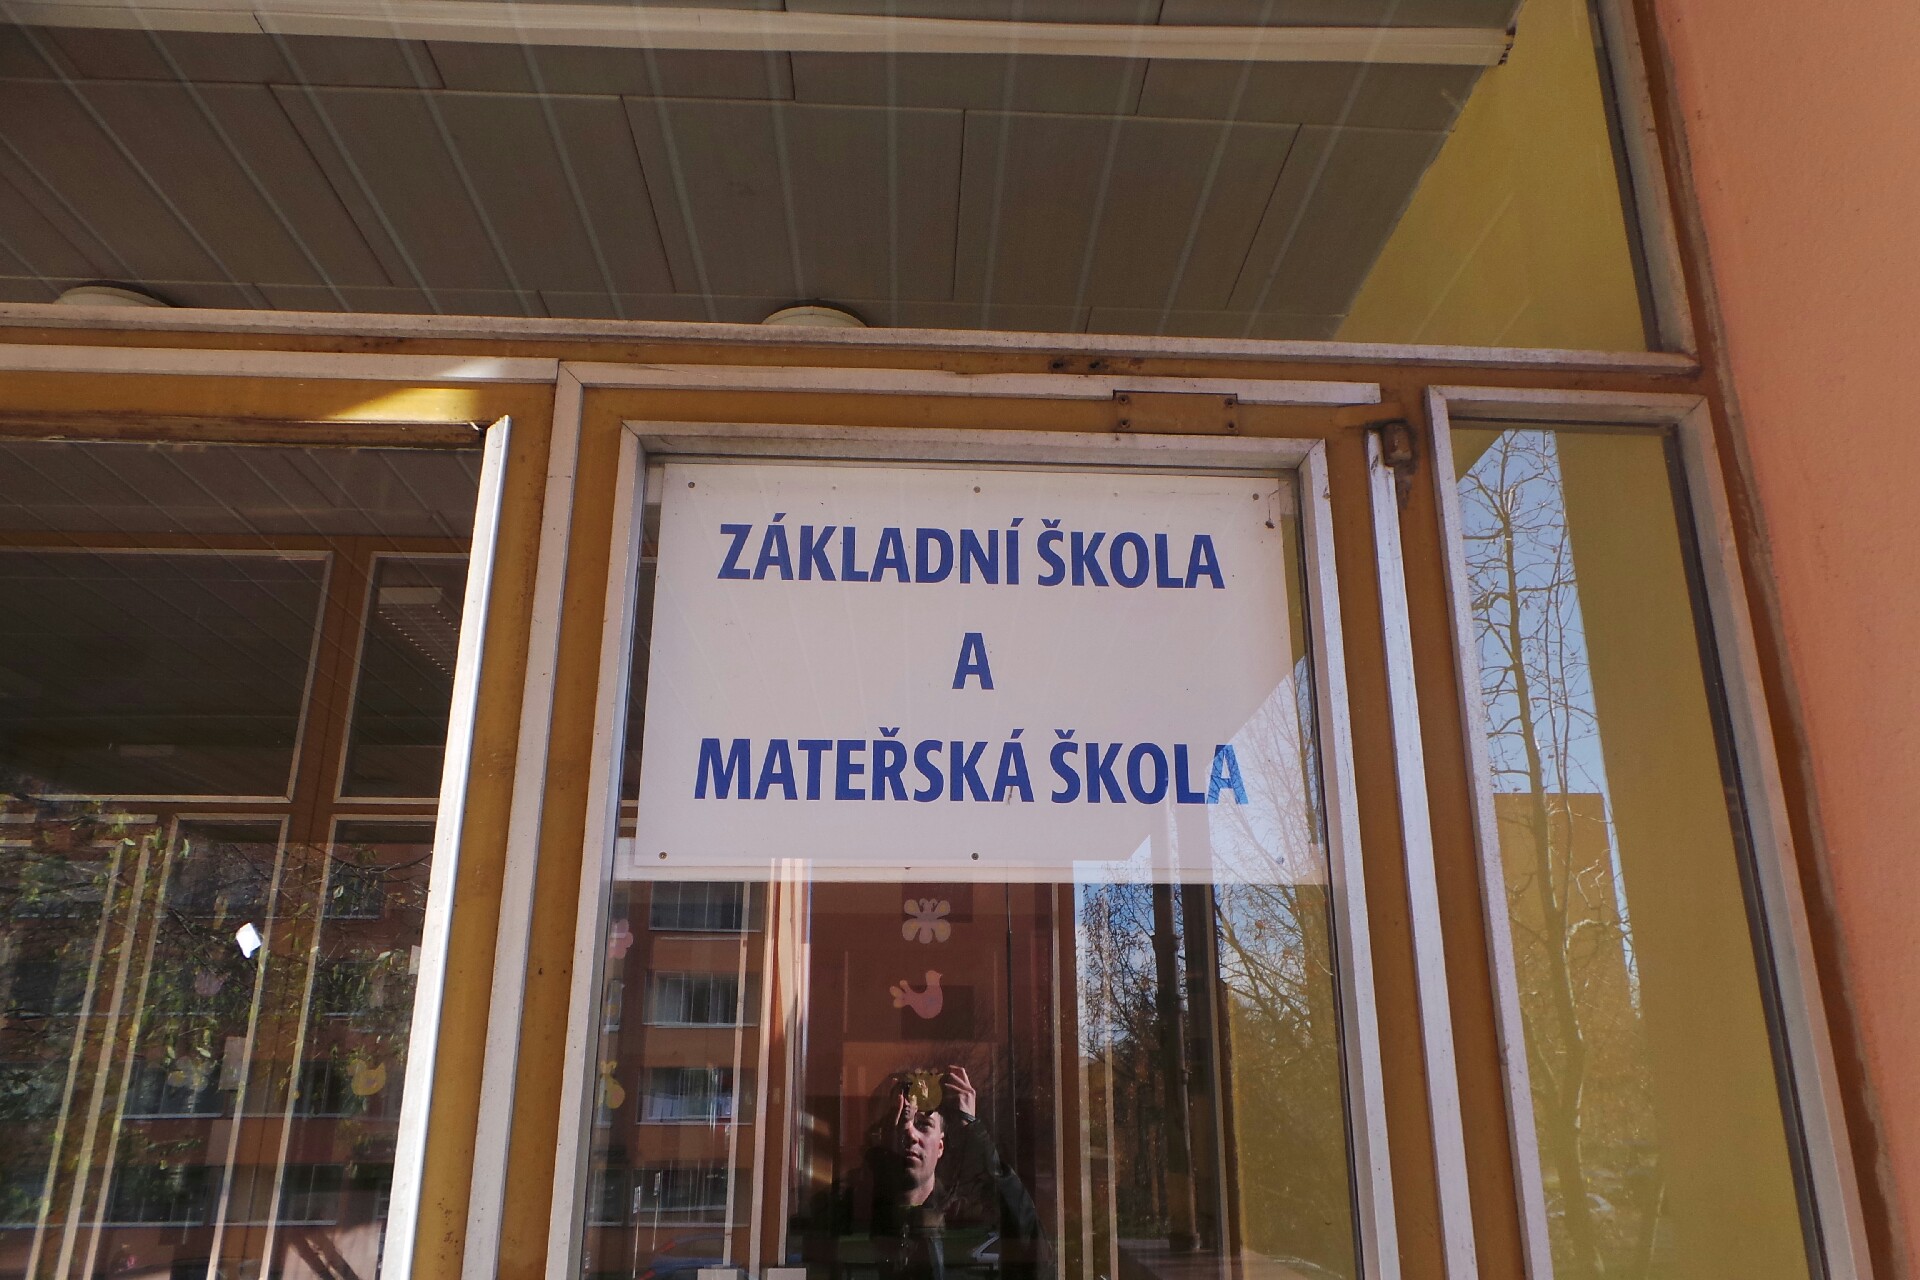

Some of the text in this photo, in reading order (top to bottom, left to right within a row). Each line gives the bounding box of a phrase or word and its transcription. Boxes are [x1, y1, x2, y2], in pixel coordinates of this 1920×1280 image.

[717, 512, 1225, 589] ZÁKLADNÍ ŠKOLA
[952, 632, 994, 690] A
[694, 727, 1249, 806] MATEŘSKÁ ŠKOLA
